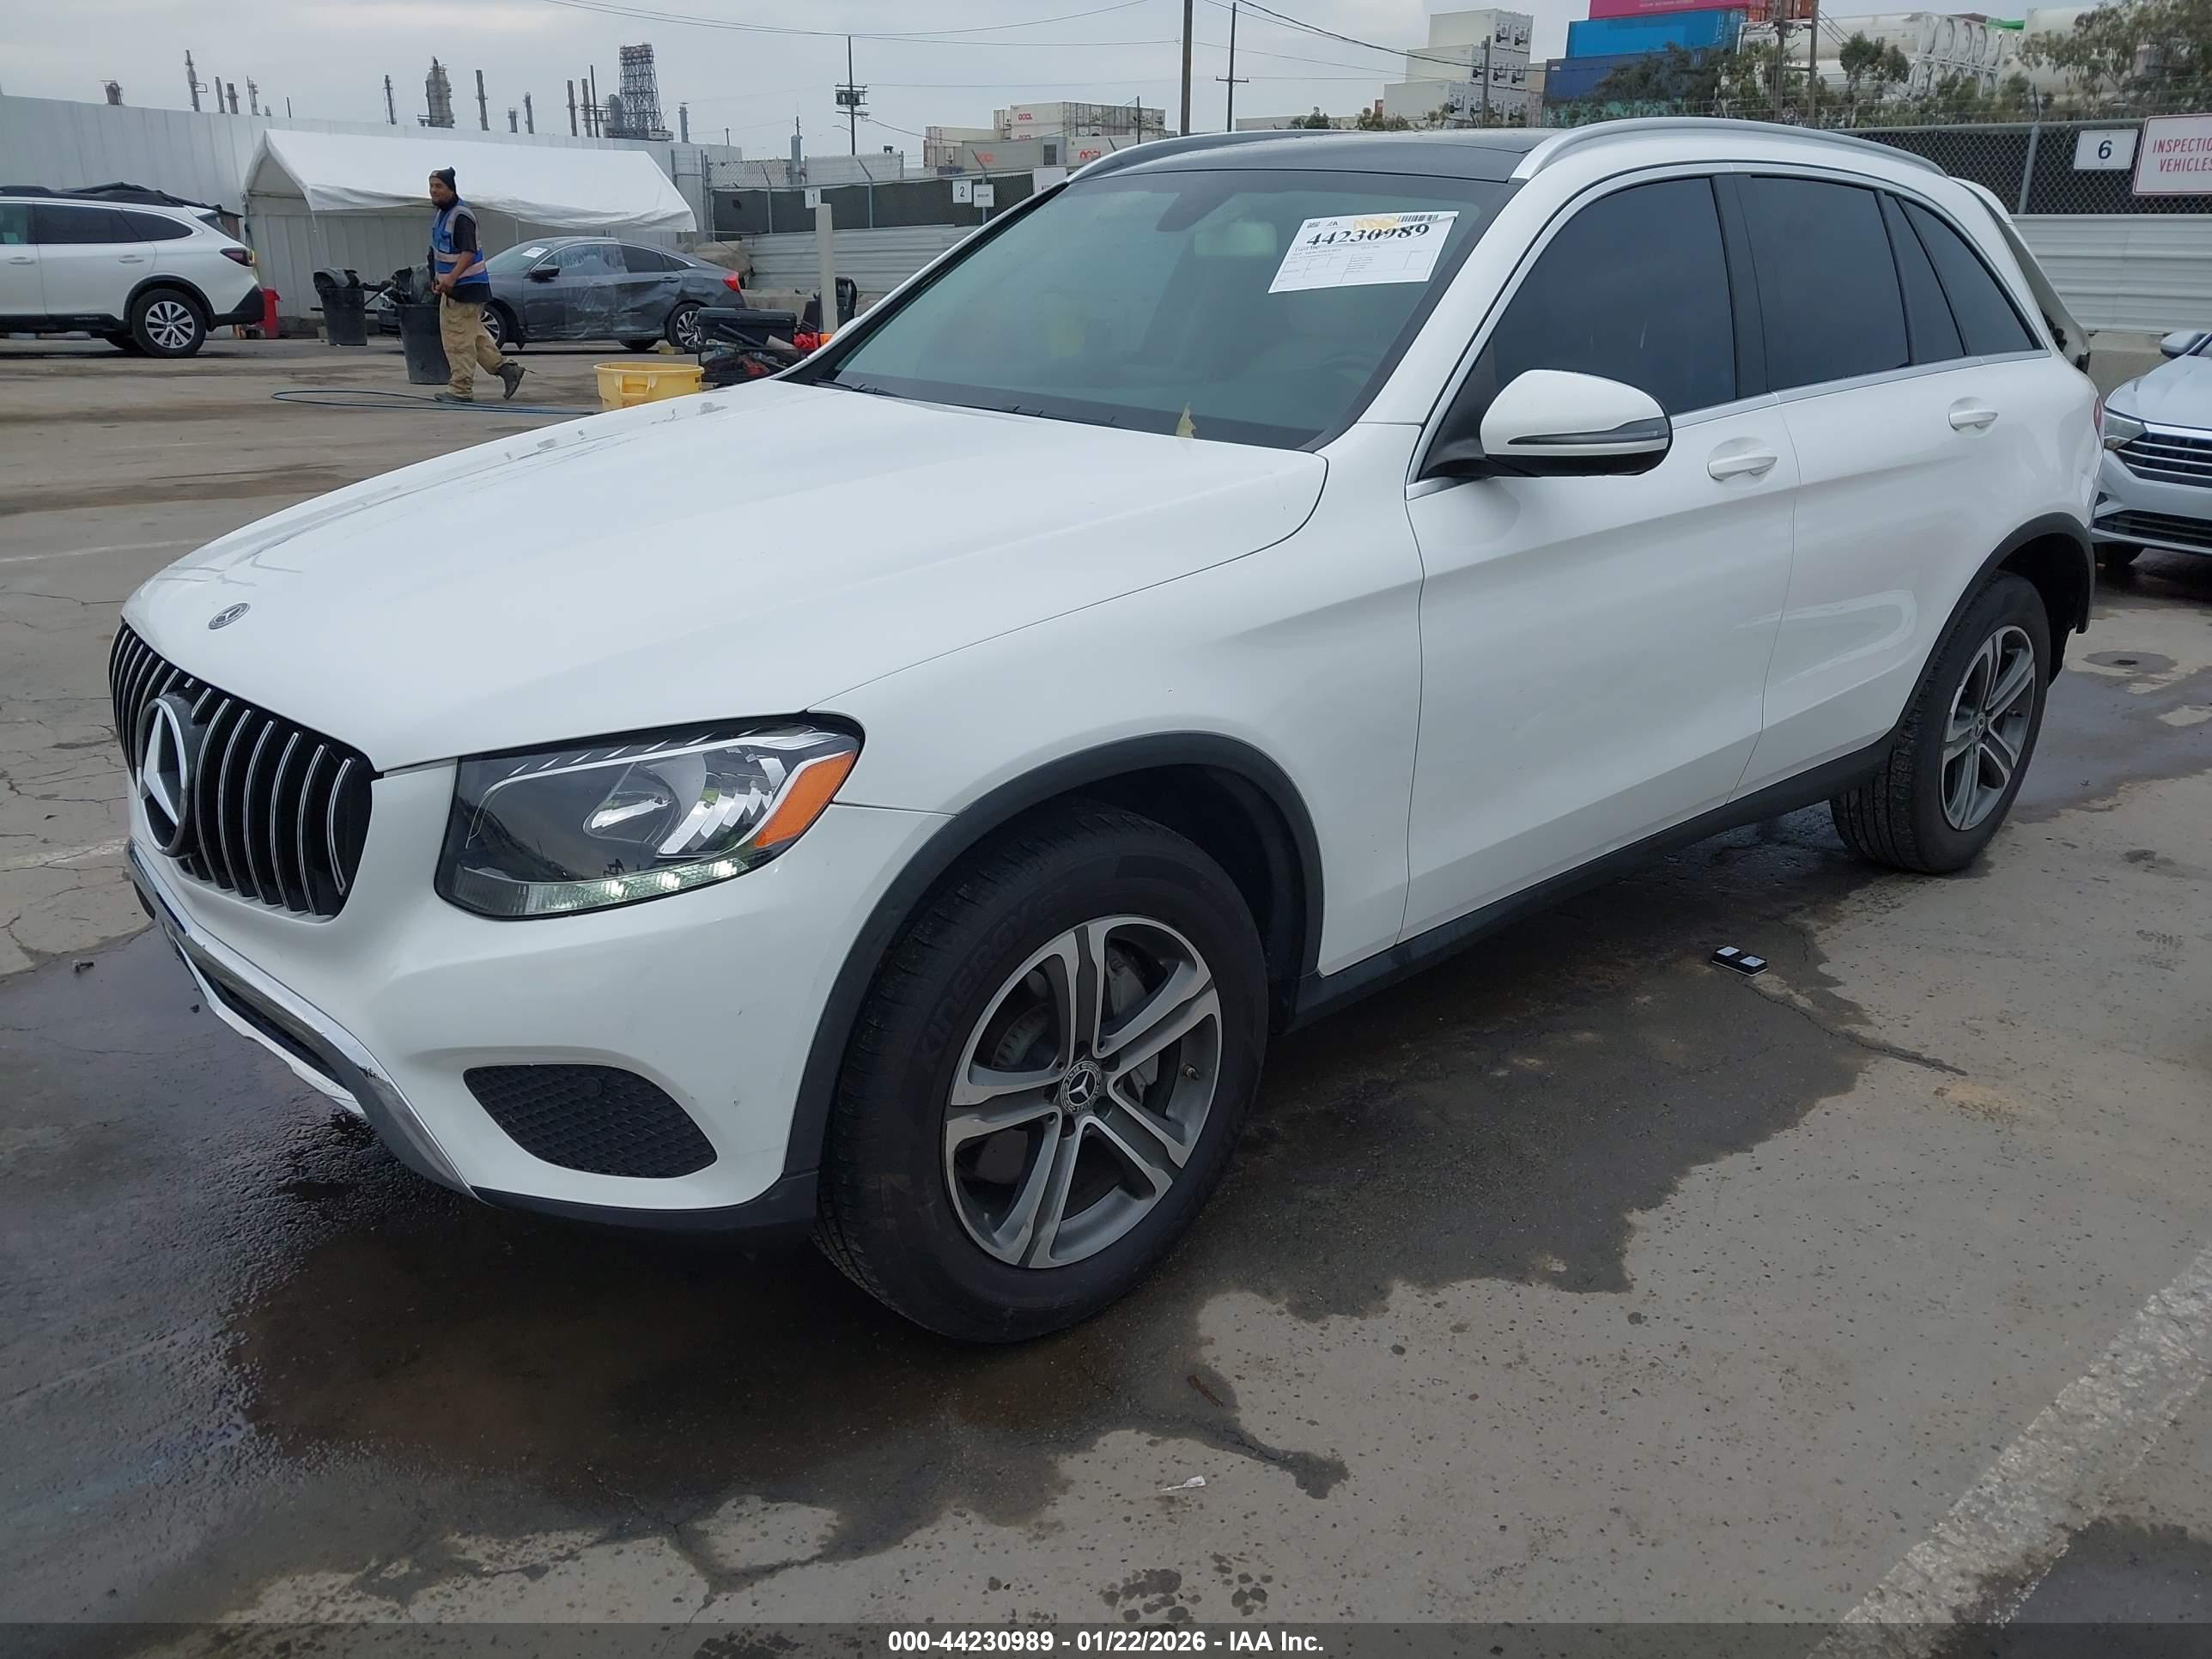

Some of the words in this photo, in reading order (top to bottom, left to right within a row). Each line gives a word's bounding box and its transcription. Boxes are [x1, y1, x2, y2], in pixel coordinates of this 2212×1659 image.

[2098, 140, 2112, 160] 6
[2160, 157, 2212, 173] VEHICLES
[959, 185, 965, 198] 2
[1305, 223, 1430, 246] 44230989
